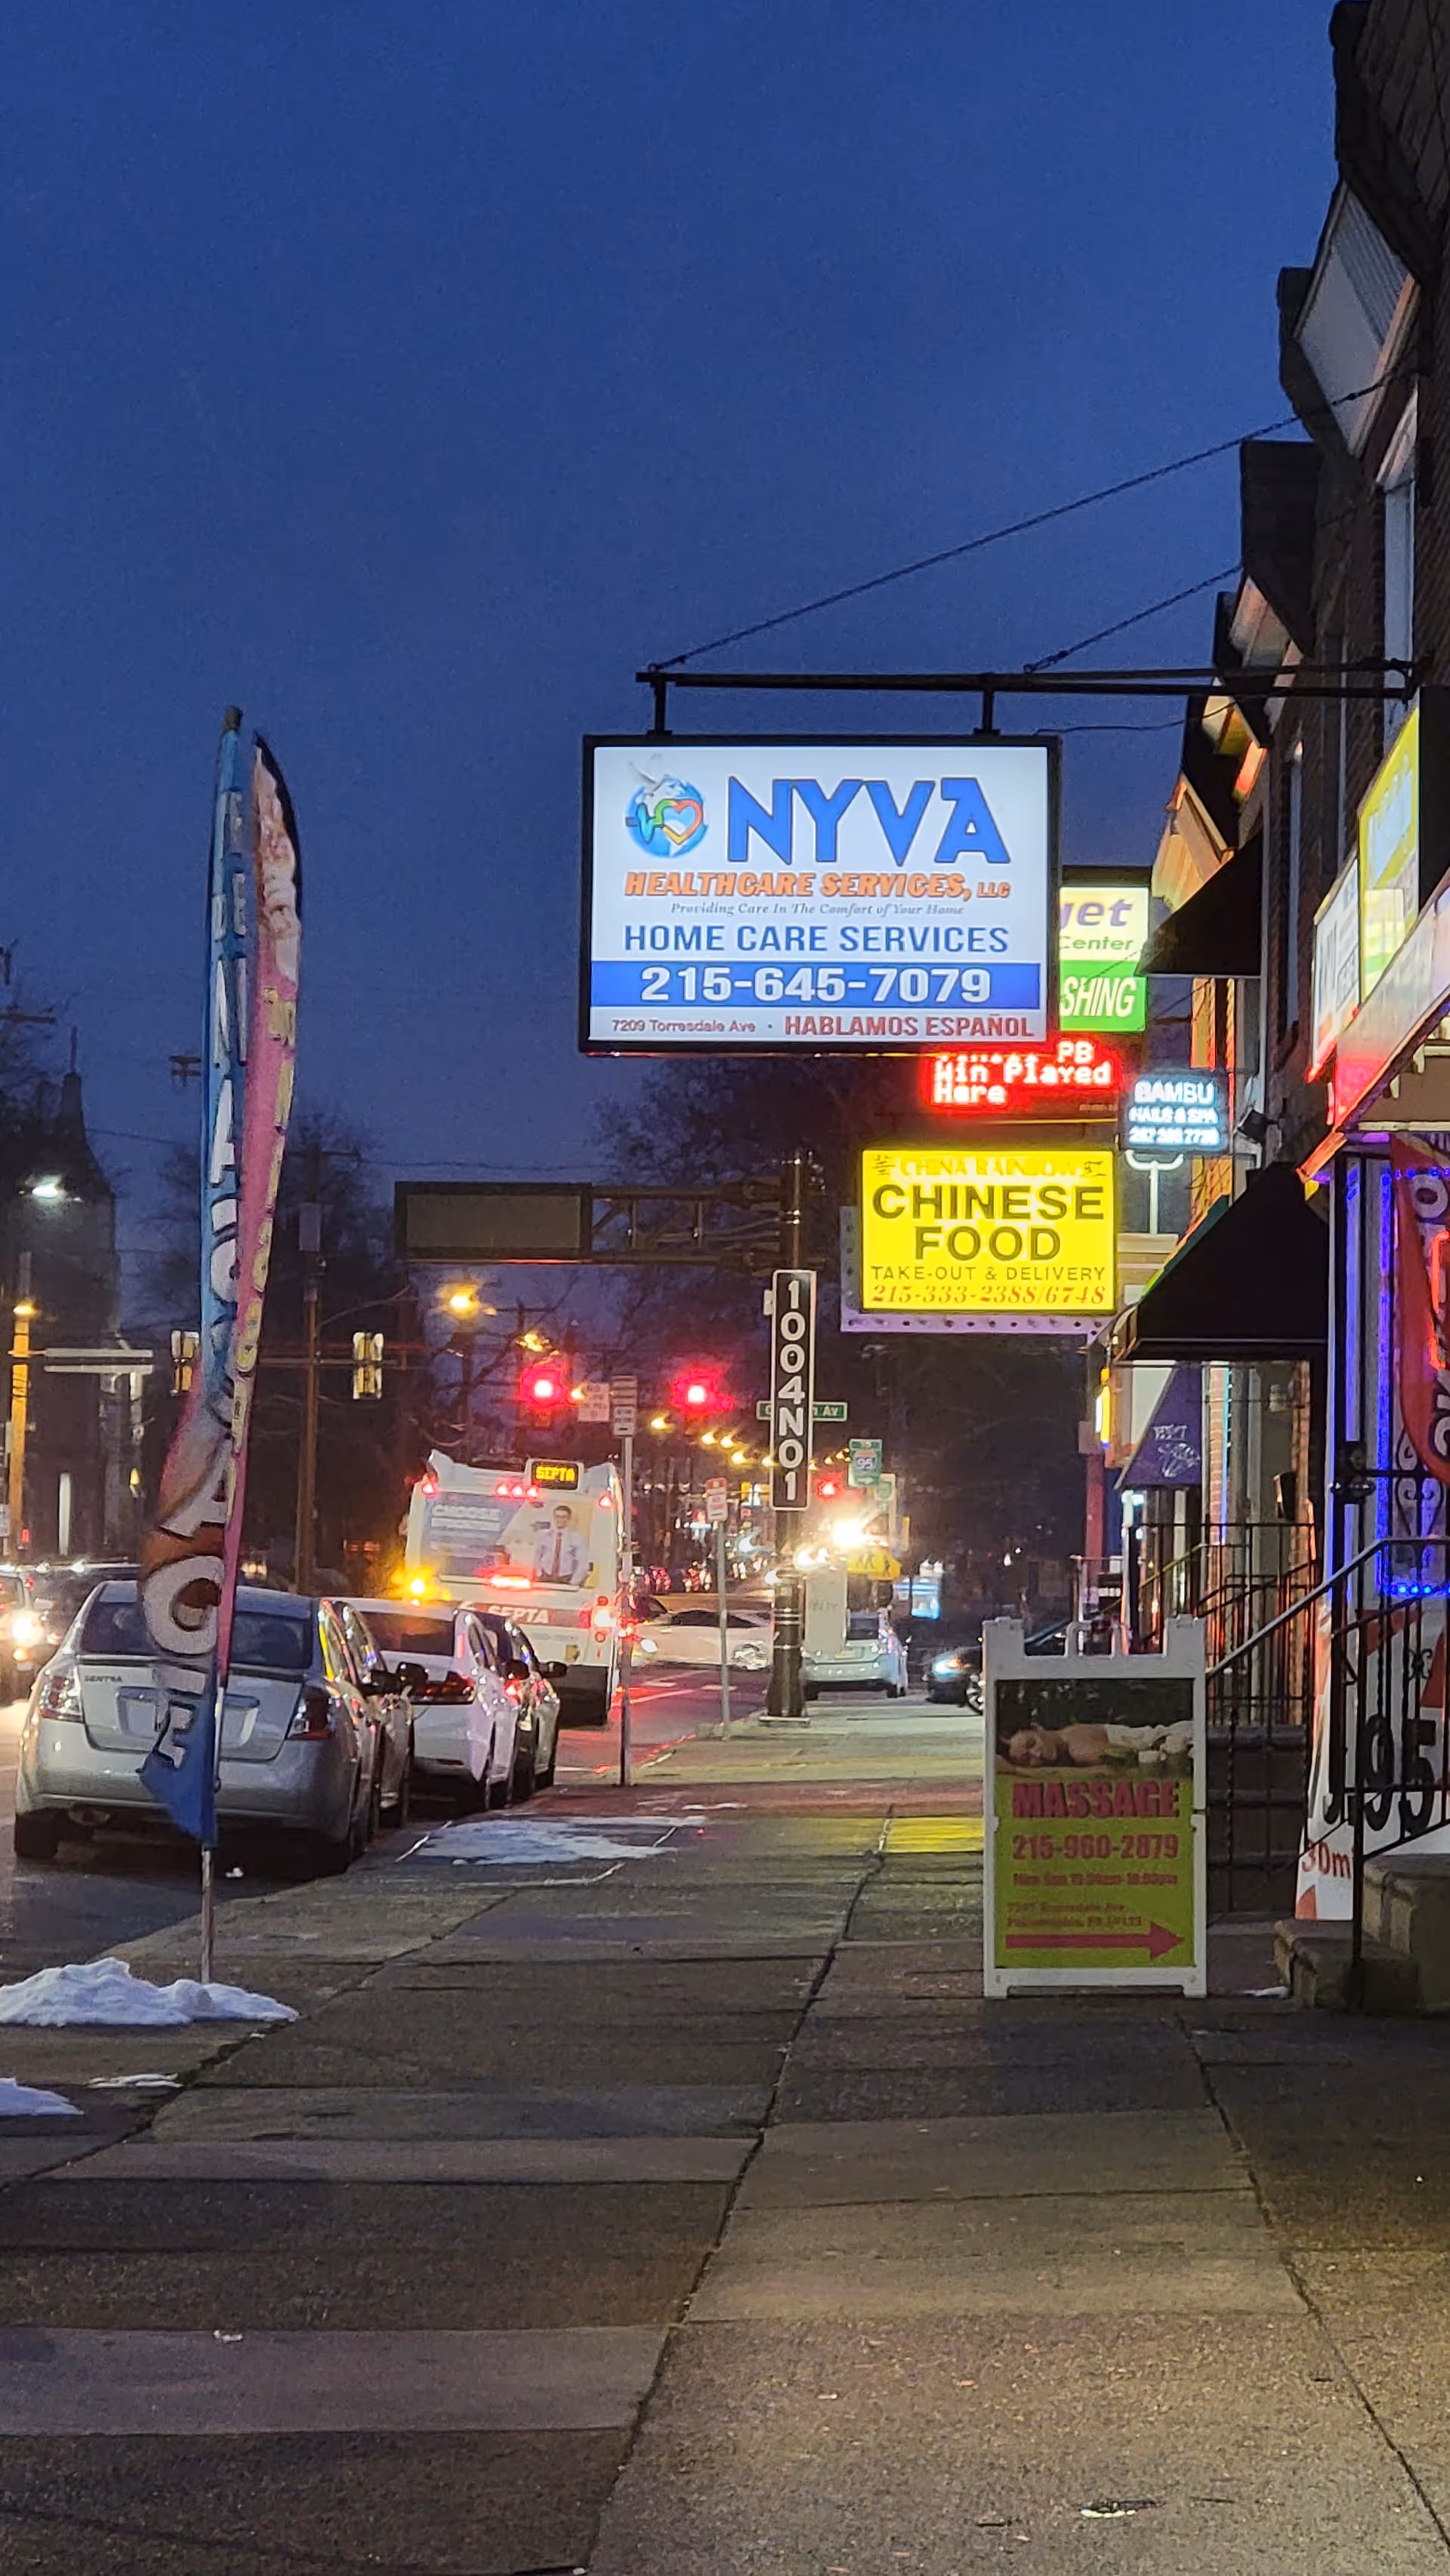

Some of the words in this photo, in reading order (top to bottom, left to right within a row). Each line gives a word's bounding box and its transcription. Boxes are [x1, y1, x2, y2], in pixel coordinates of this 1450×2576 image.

[728, 775, 1010, 866] NYVA
[625, 872, 816, 897] HEALTHCARE
[820, 873, 972, 901] SERVICES,
[976, 882, 1011, 897] LLC
[671, 902, 734, 916] Providing
[738, 903, 769, 914] Care
[773, 903, 787, 914] In
[792, 903, 815, 914] The
[819, 903, 872, 917] Comfort
[877, 903, 892, 917] of
[894, 903, 923, 915] Your
[927, 903, 964, 915] Home
[625, 925, 725, 951] HOME
[737, 925, 828, 951] CARE
[839, 926, 1009, 952] SERVICES
[641, 965, 992, 1003] 215-645-7079
[649, 1019, 725, 1032] Torresdale
[730, 1019, 756, 1032] Ave
[785, 1015, 918, 1036] HABLAMOS
[925, 1012, 1034, 1036] ESPAÑOL
[1003, 1058, 1111, 1085] Played
[1134, 1080, 1215, 1104] BAMBU
[872, 1184, 1105, 1221] CHINESE
[915, 1225, 1062, 1261] FOOD
[871, 1266, 976, 1280] TAKE-OUT
[985, 1266, 998, 1280] &
[1006, 1266, 1106, 1281] DELIVERY
[535, 1465, 576, 1482] SEPTA
[857, 1457, 874, 1471] 95
[85, 1675, 123, 1683] SENTRA
[1012, 1781, 1180, 1818] MASSAGE
